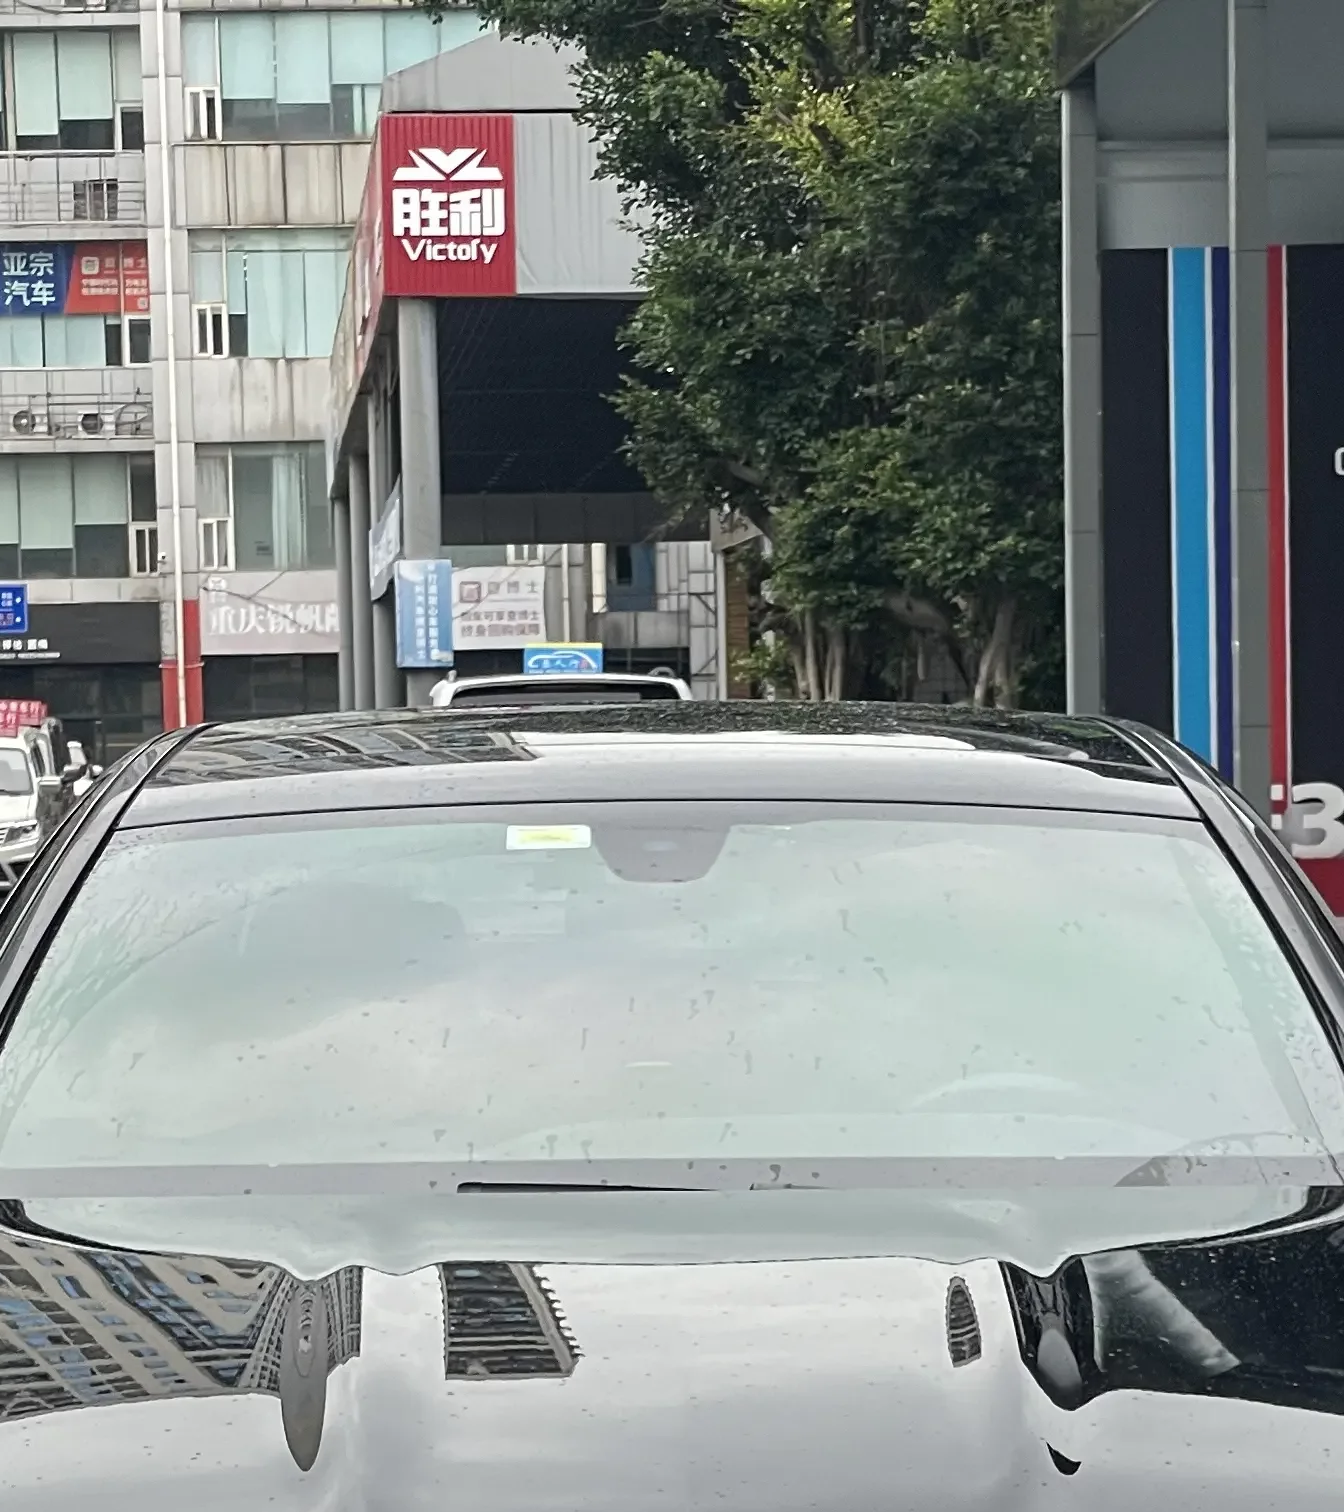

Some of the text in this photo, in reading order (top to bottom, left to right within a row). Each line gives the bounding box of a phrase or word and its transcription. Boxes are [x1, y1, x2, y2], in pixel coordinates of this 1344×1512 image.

[392, 188, 506, 237] 胜利
[2, 251, 54, 276] 亚宗
[401, 238, 498, 264] Victory
[3, 280, 56, 306] 汽车
